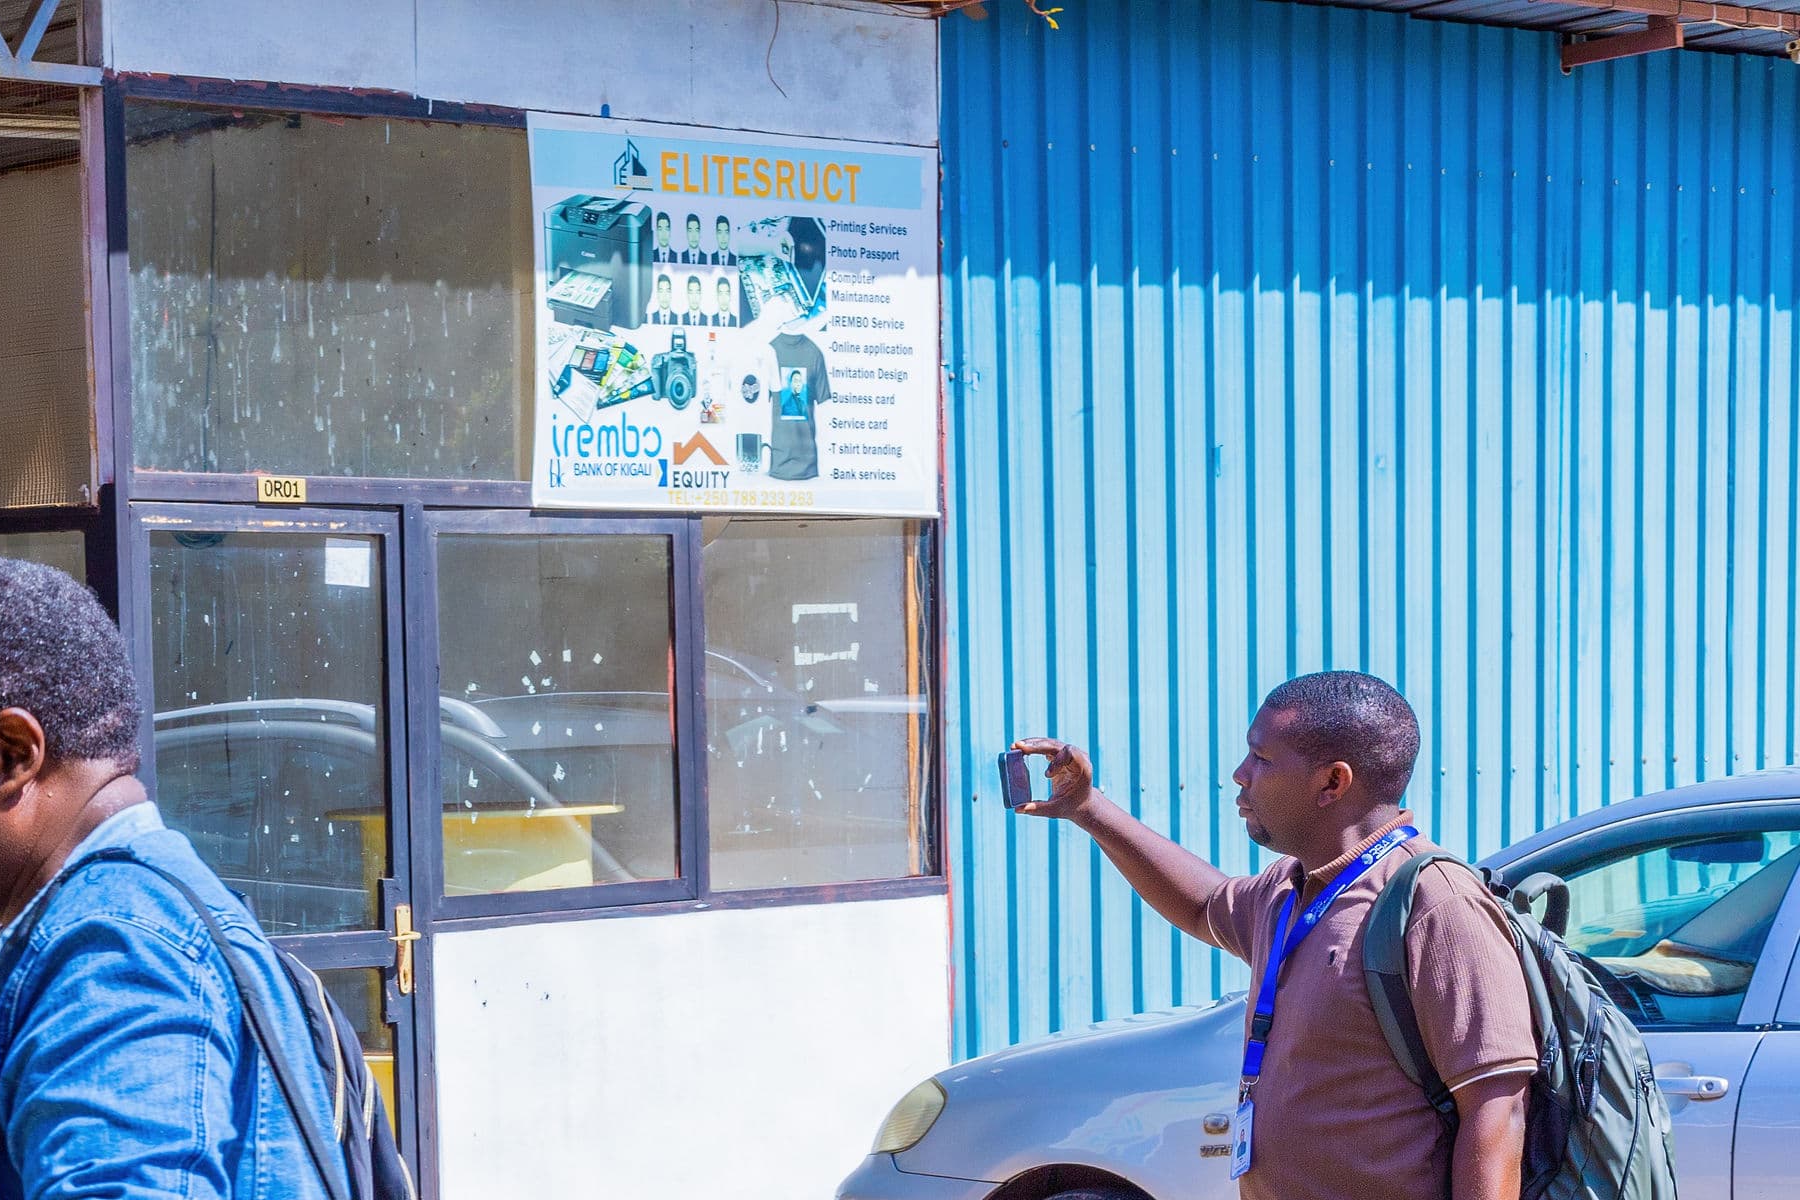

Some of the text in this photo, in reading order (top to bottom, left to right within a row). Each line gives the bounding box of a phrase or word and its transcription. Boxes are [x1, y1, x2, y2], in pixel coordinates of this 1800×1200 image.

[660, 151, 862, 203] ELITESRUCT
[869, 222, 908, 236] Services
[860, 247, 900, 262] Passport
[831, 290, 891, 304] Maintanance
[871, 317, 905, 330] Service
[863, 342, 913, 357] application
[878, 368, 908, 383] Design
[875, 393, 895, 405] card
[868, 418, 888, 430] card
[839, 443, 860, 455] shirt
[862, 444, 903, 459] branding
[574, 462, 602, 476] BANK
[604, 462, 619, 476] OF
[621, 462, 652, 476] KIGALI
[859, 469, 896, 481] services
[673, 471, 730, 489] EQUITY
